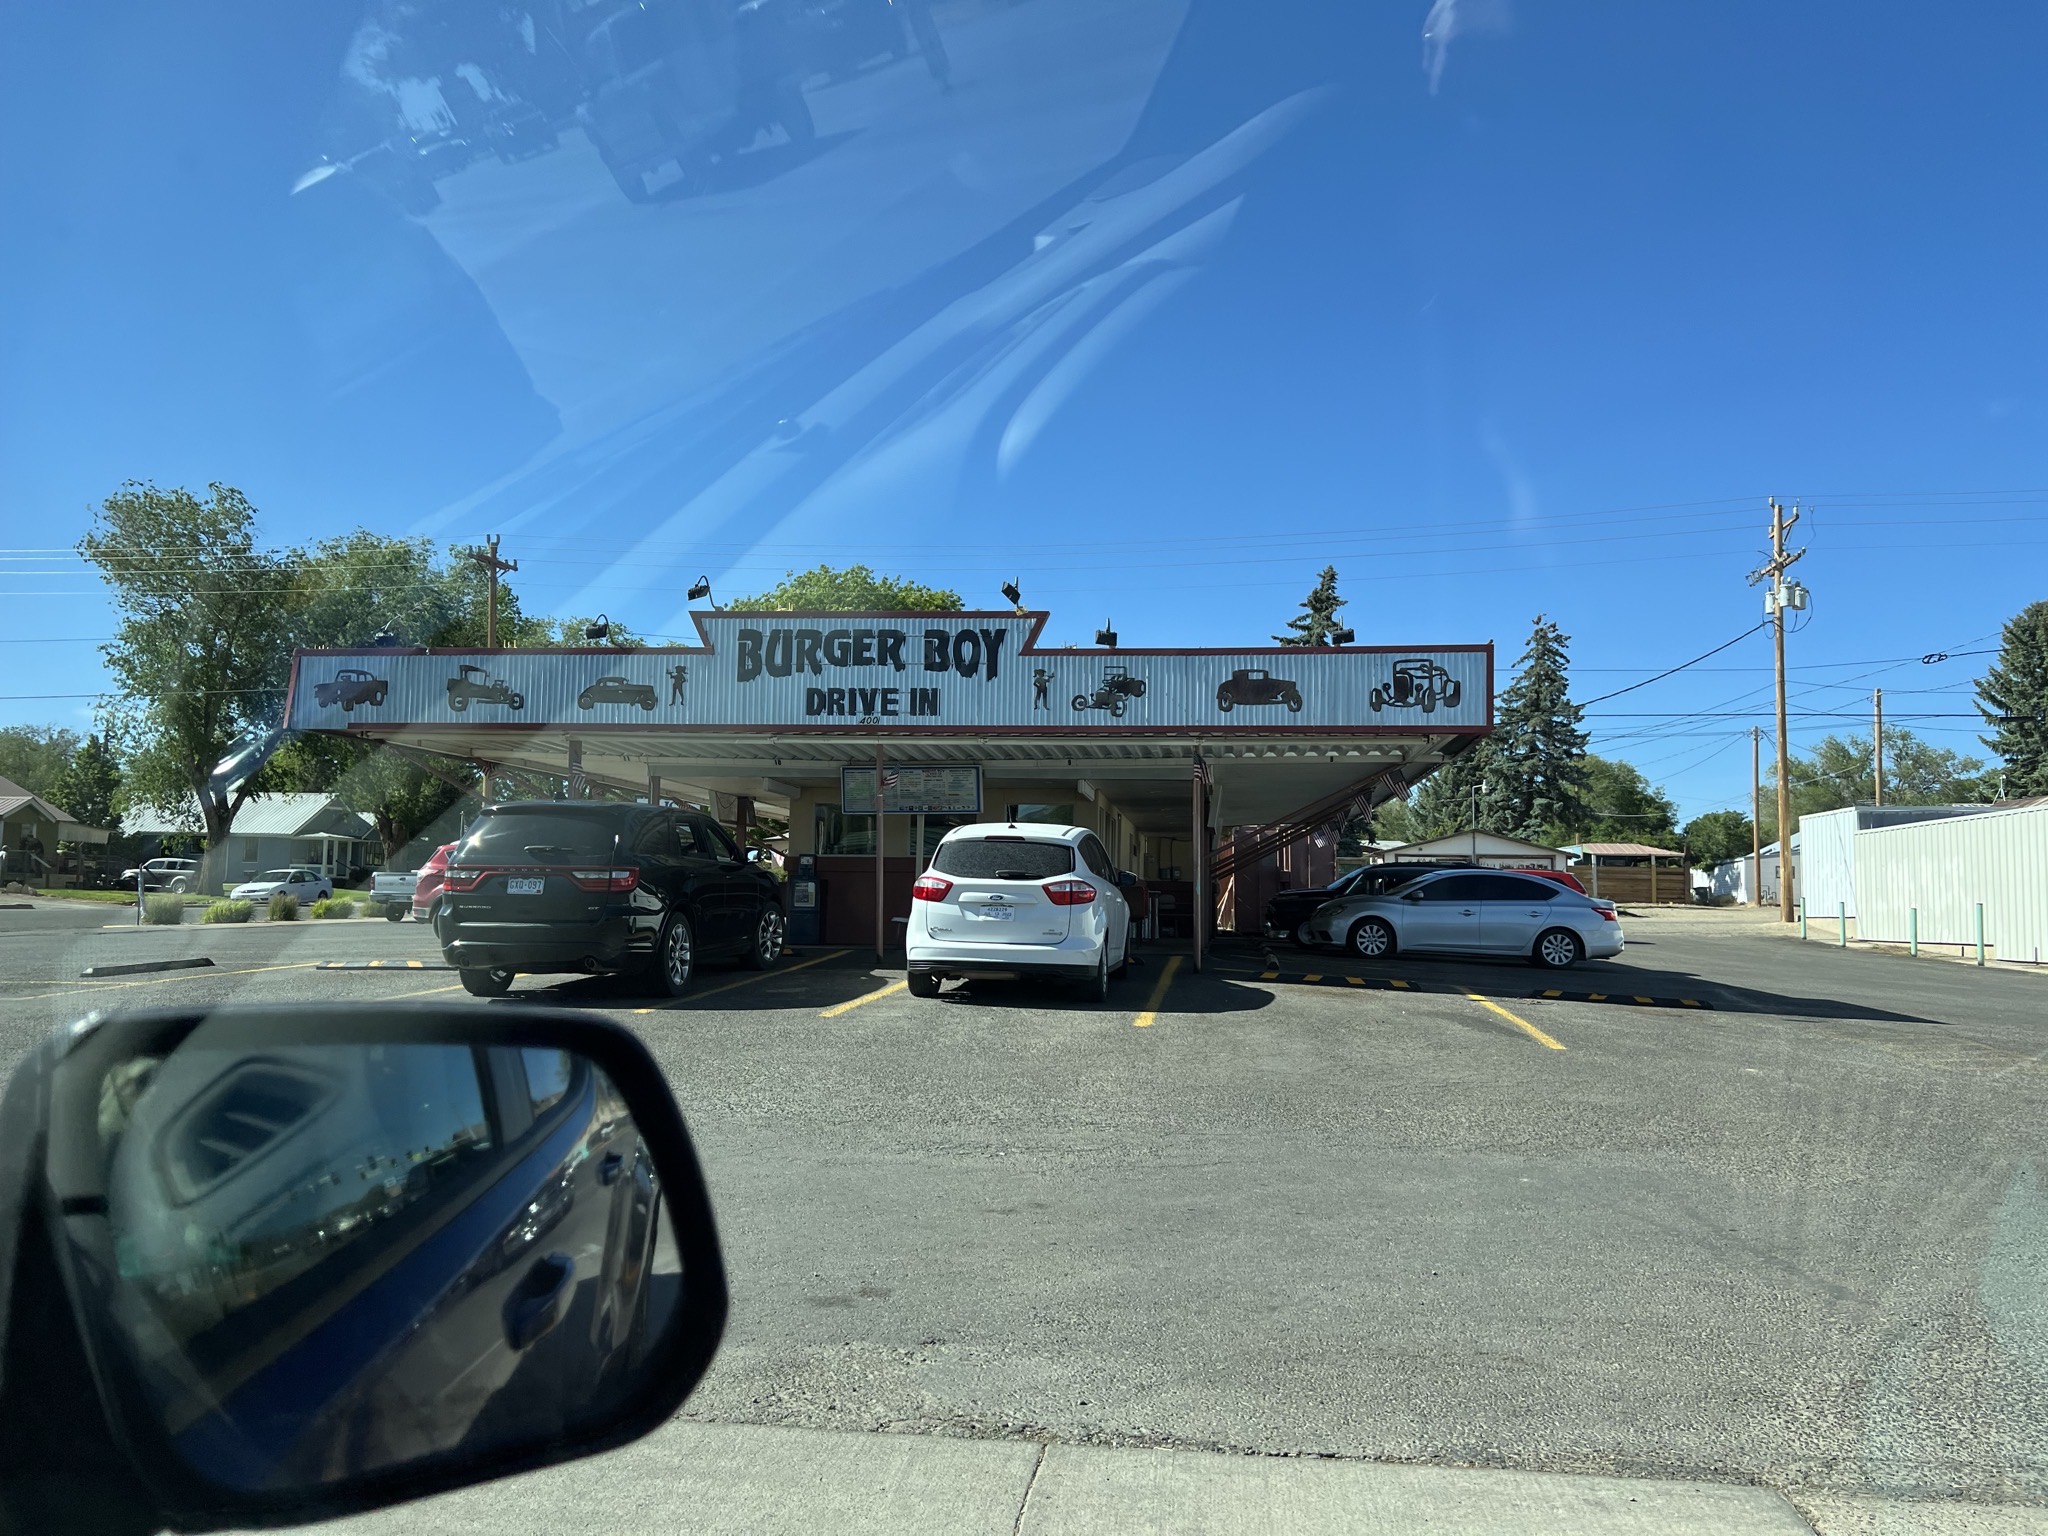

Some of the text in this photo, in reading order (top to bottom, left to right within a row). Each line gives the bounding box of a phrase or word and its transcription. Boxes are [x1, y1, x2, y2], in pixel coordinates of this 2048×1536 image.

[736, 628, 1008, 682] BURGER BOY
[806, 687, 941, 716] DRIVE IN
